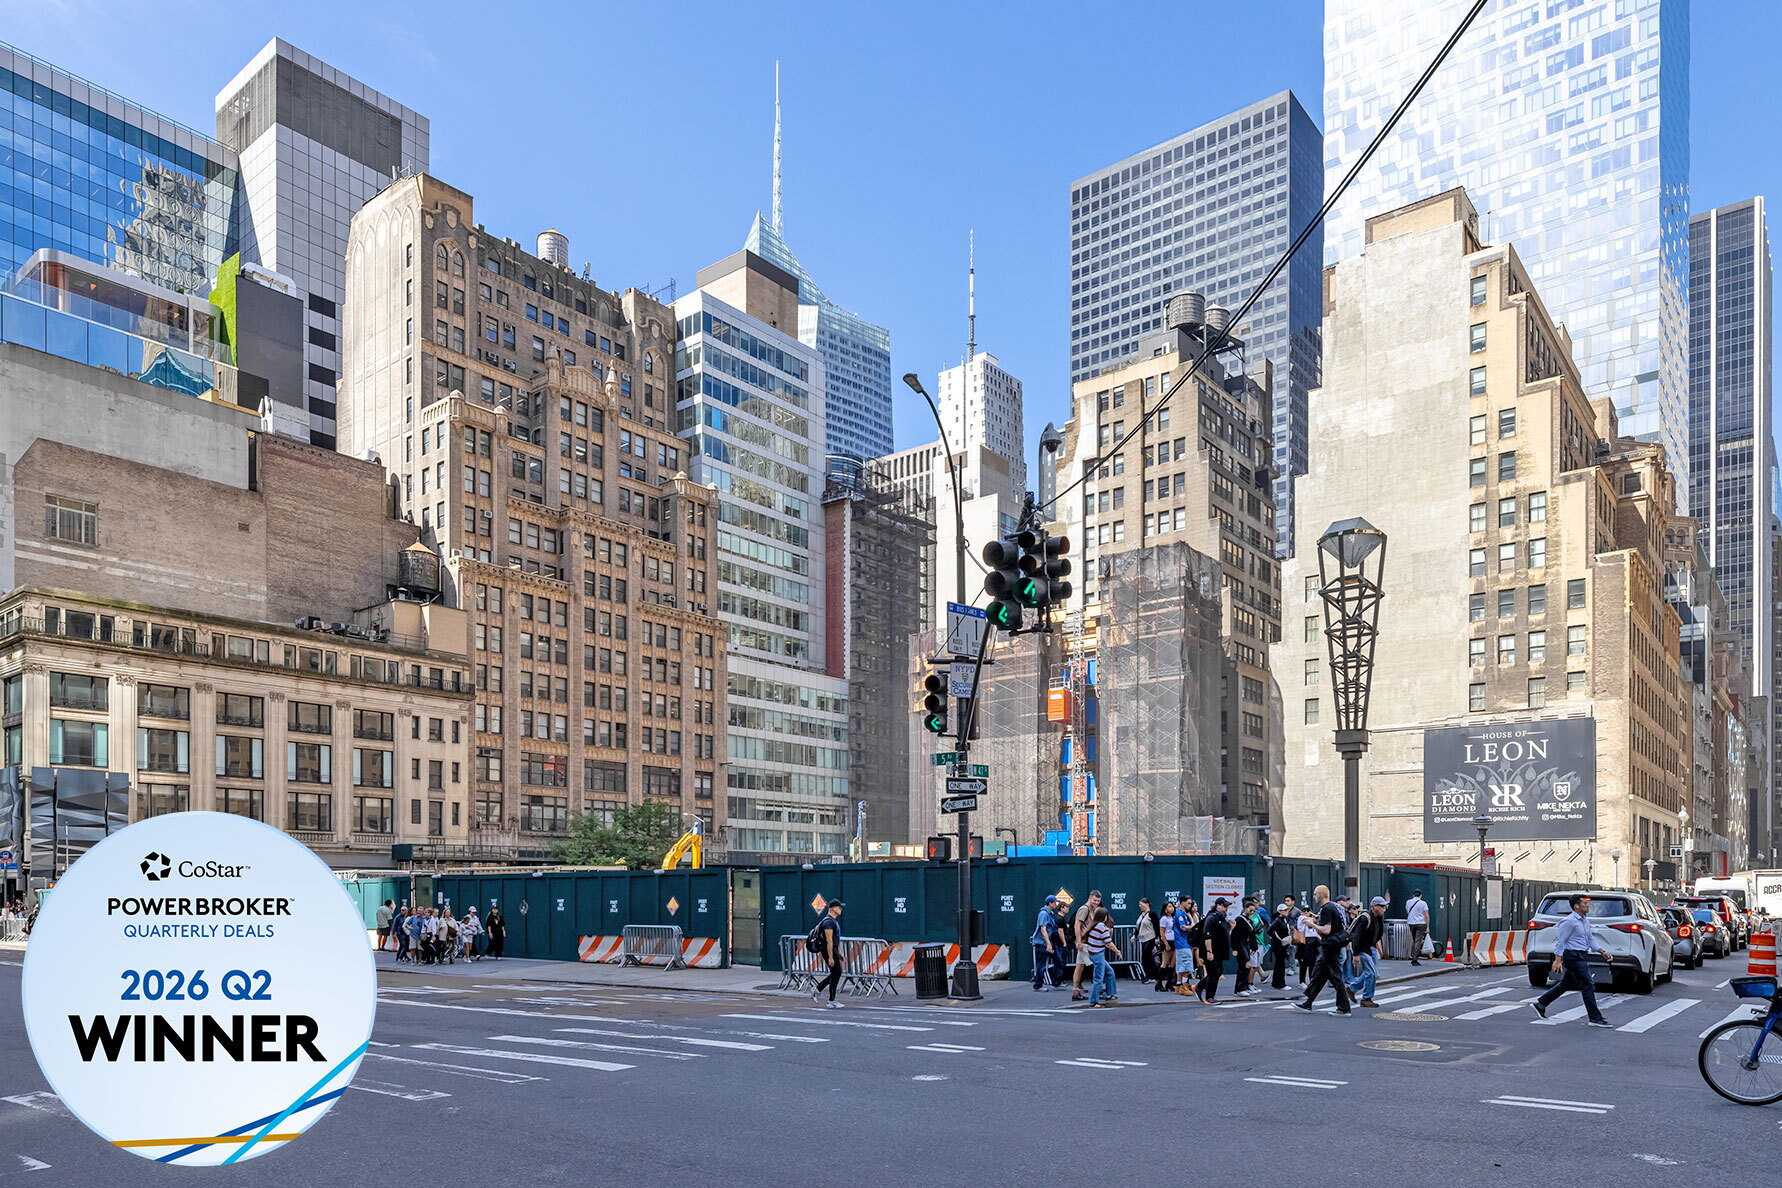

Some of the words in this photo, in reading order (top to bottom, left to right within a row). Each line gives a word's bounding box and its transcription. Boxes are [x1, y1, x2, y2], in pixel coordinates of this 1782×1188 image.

[954, 665, 975, 673] NYPD
[1482, 732, 1512, 740] HOUSE
[1515, 730, 1528, 738] OF
[1464, 739, 1549, 763] LEON
[941, 754, 946, 764] 5
[962, 799, 974, 807] WAY
[1432, 794, 1476, 806] LEON
[1432, 805, 1476, 813] DIAMOND
